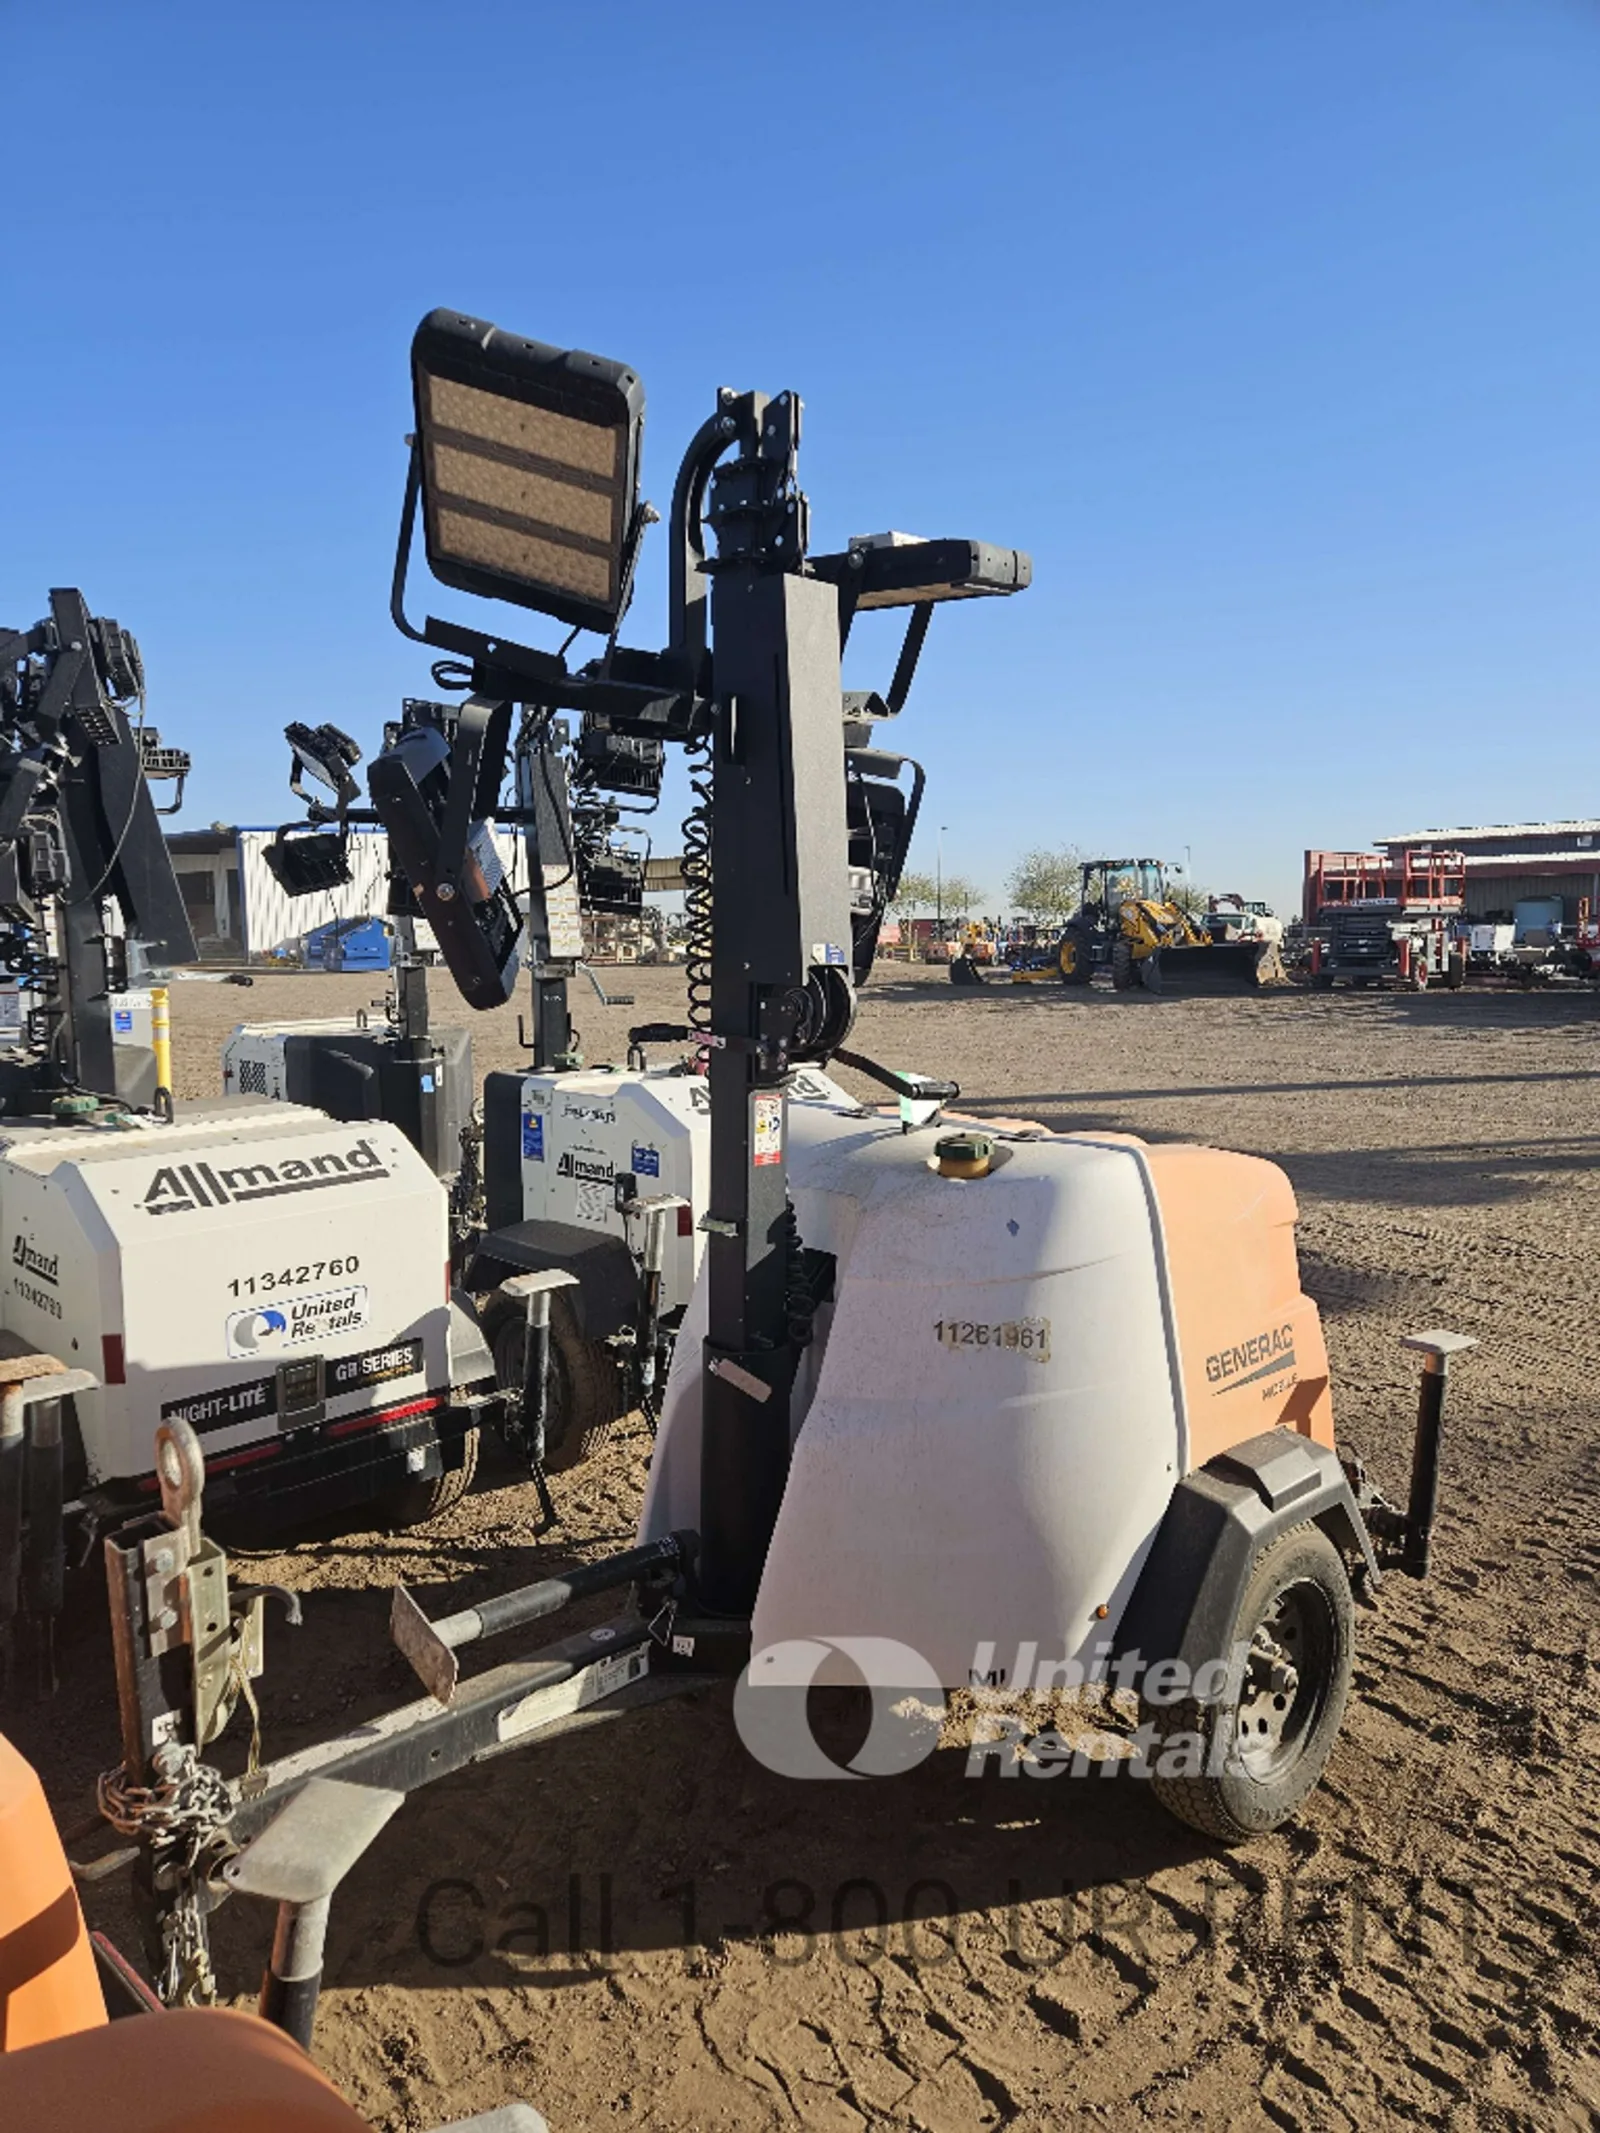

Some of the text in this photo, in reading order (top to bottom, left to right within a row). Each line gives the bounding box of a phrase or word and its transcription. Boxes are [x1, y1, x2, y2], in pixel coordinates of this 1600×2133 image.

[144, 1139, 382, 1207] Allmand
[227, 1255, 360, 1297] 11342760
[291, 1291, 358, 1321] United
[291, 1310, 362, 1338] Retals
[934, 1320, 1046, 1349] 11261961
[1206, 1323, 1294, 1383] GENERAC
